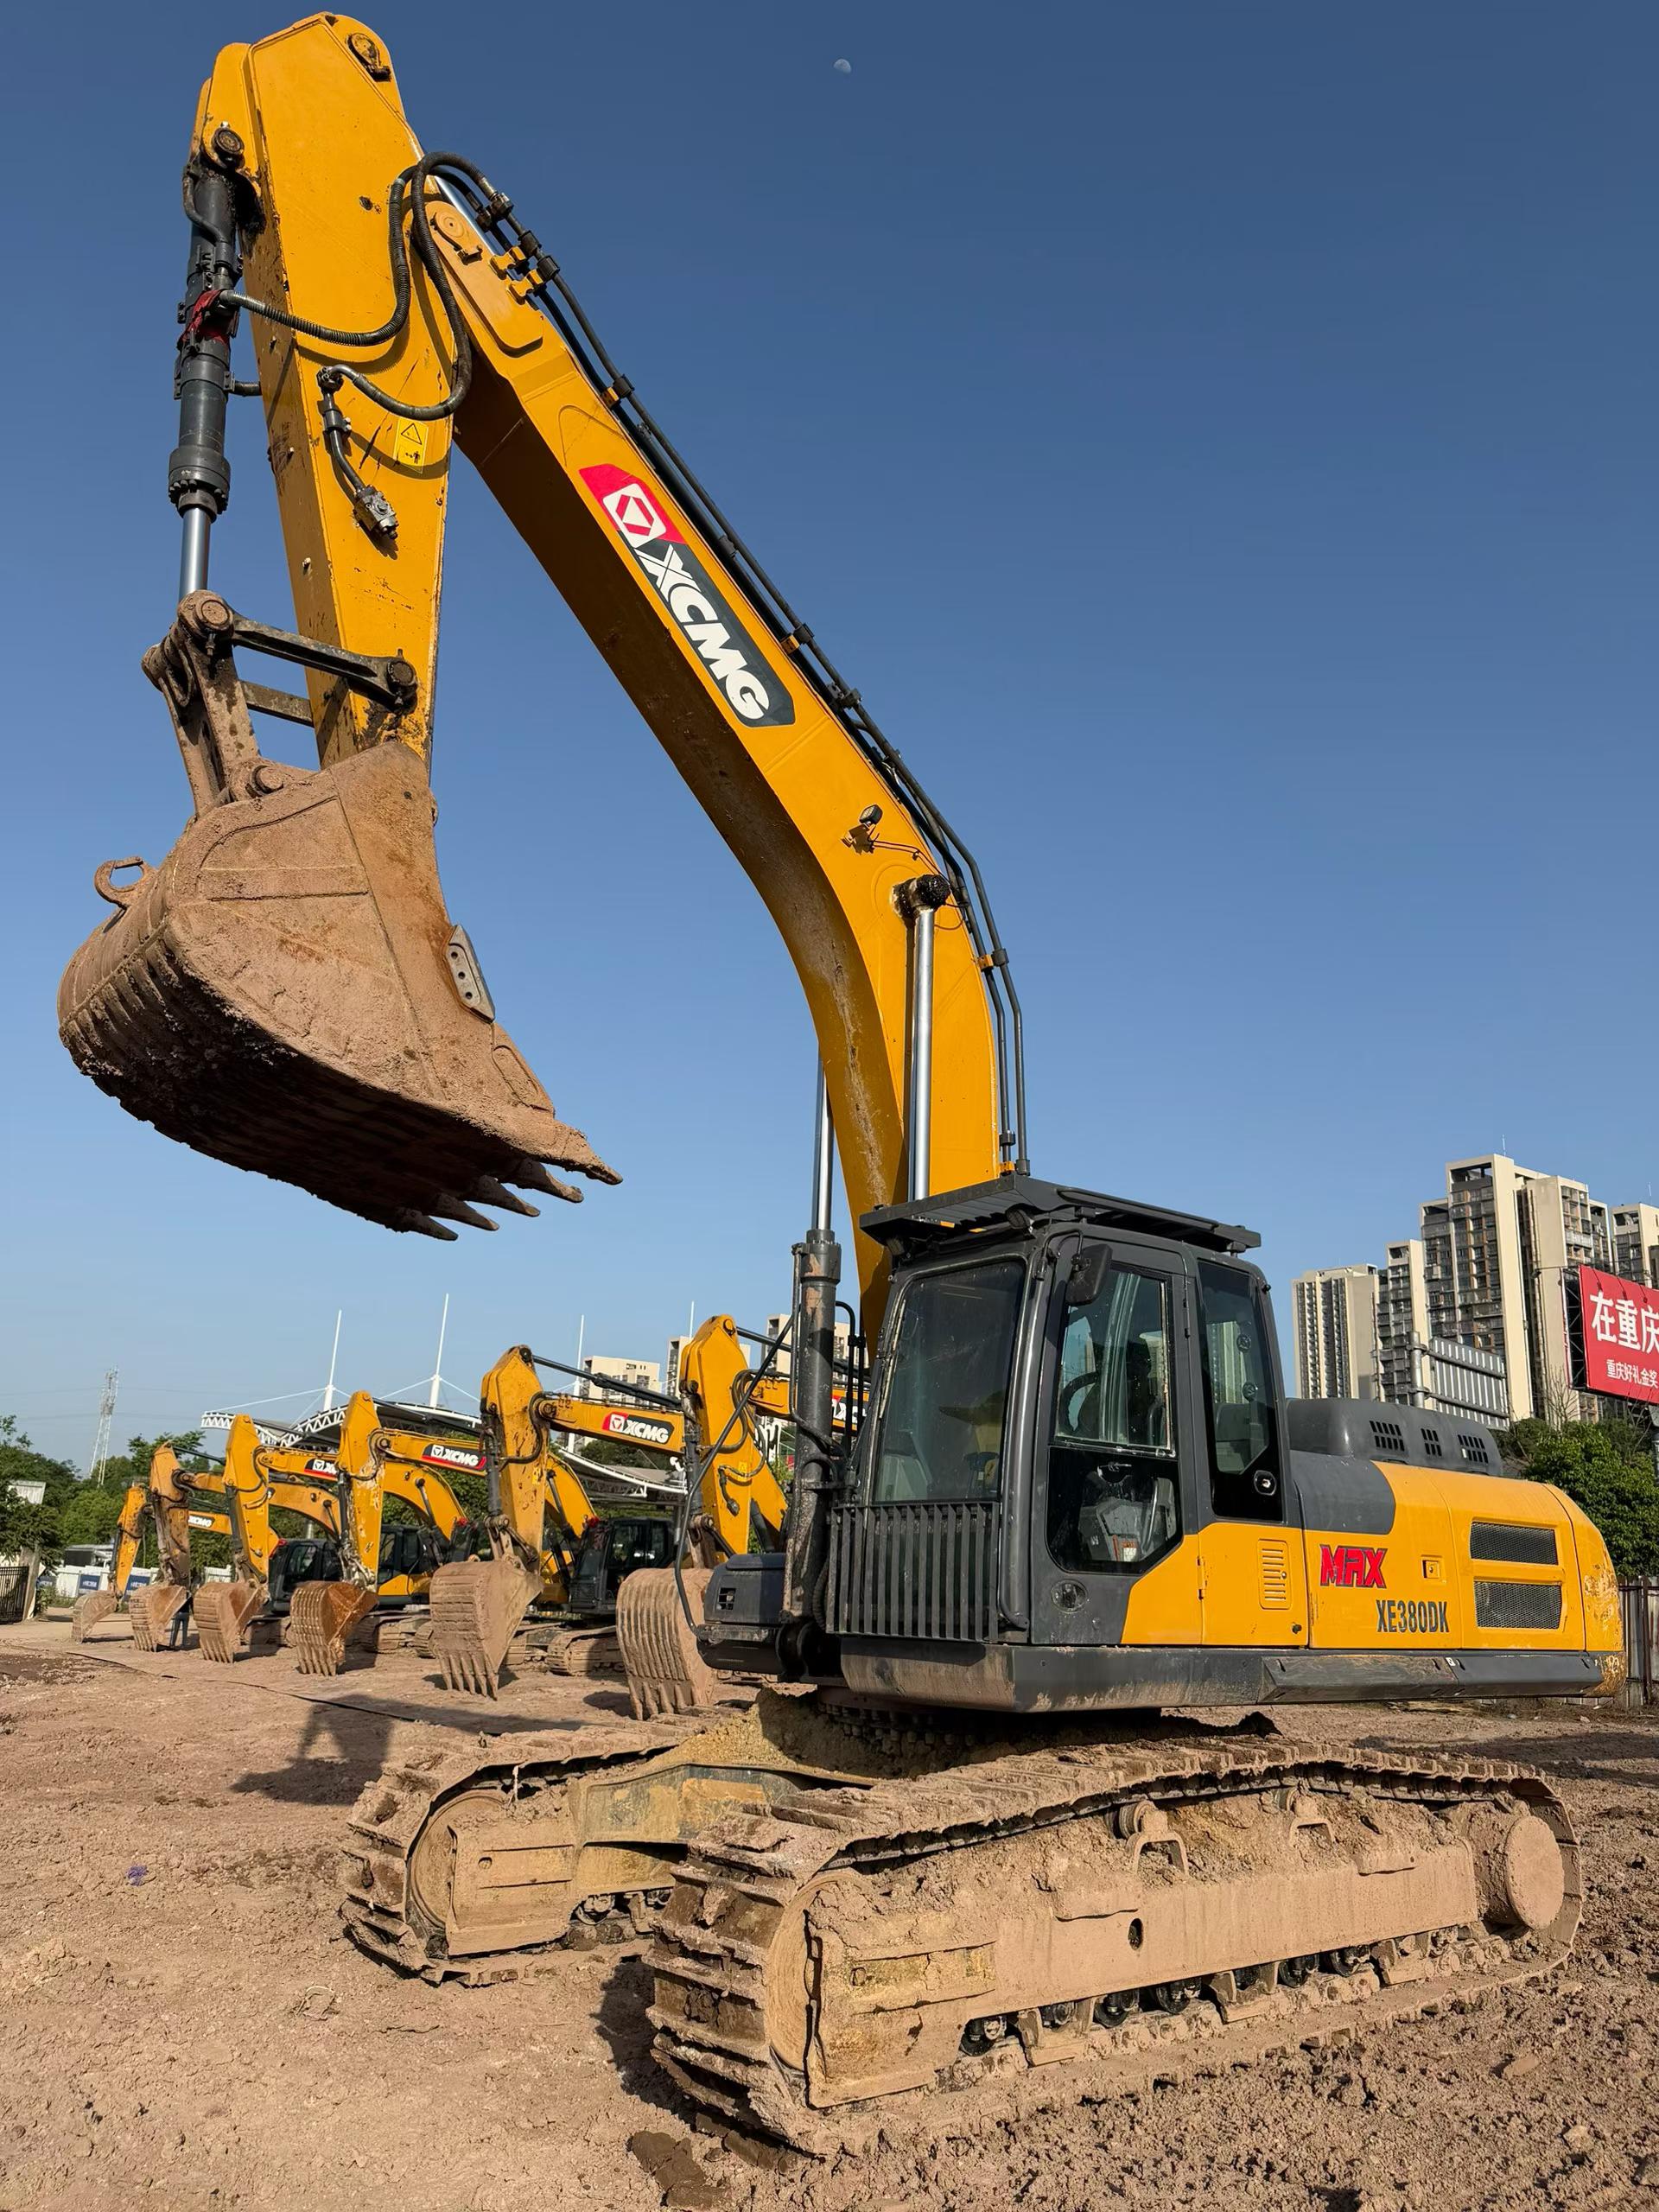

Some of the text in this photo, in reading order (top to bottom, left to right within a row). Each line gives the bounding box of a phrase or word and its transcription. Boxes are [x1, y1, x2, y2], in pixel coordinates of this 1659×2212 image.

[633, 543, 770, 720] XCMG
[1589, 1291, 1659, 1354] 在重庆
[622, 1419, 669, 1444] XCMG
[442, 1448, 479, 1466] XCMG
[1319, 1543, 1389, 1589] MAX
[1376, 1599, 1450, 1633] XE380DK
